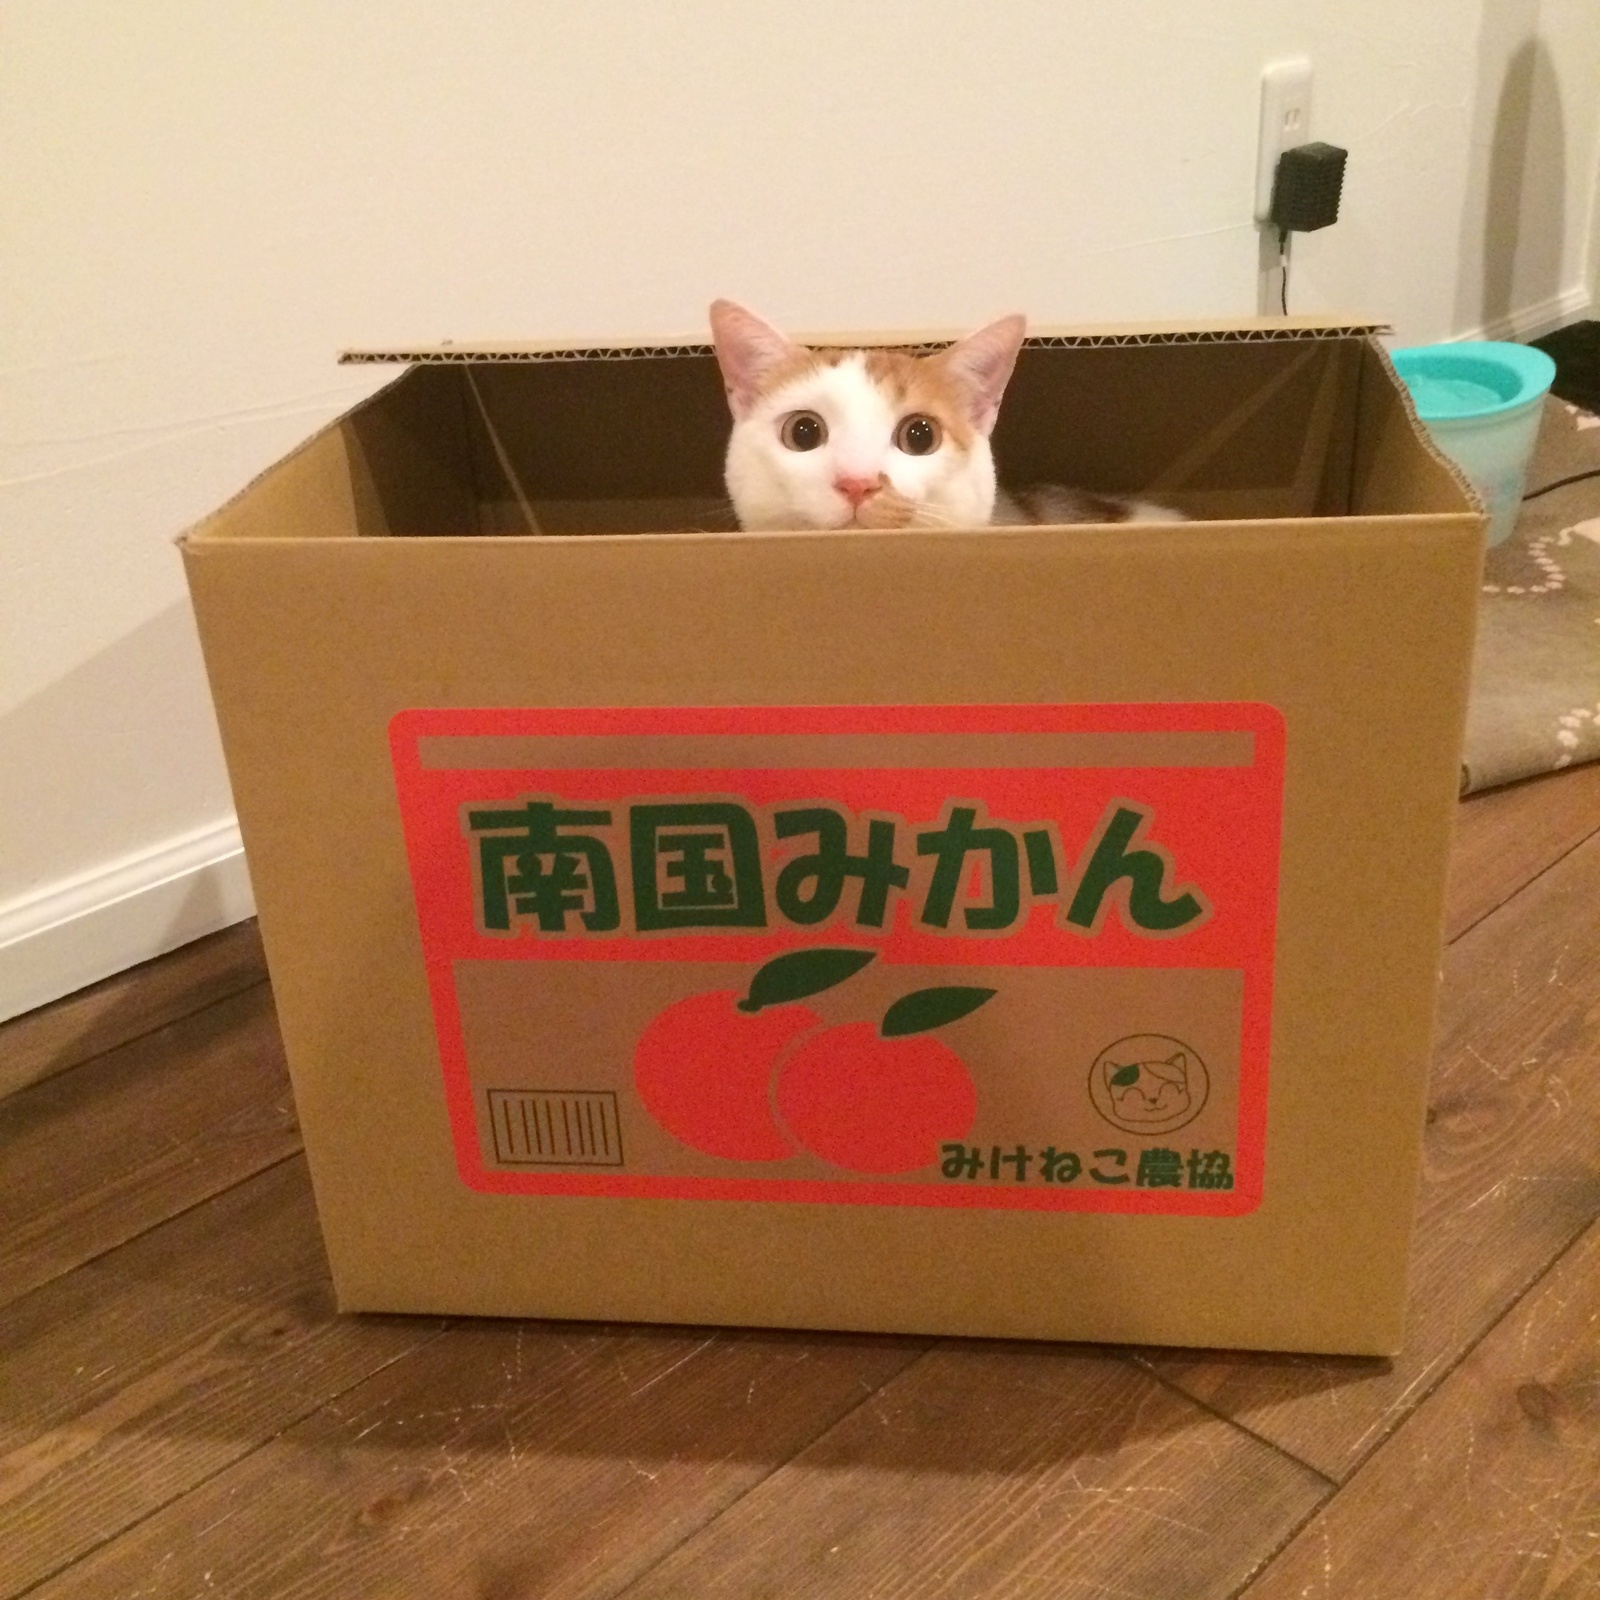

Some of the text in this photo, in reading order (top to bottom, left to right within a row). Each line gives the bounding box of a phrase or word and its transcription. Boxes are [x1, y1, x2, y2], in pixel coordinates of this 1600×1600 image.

[469, 802, 1202, 932] 南国みかん
[941, 1144, 1235, 1189] みけねこ農協
